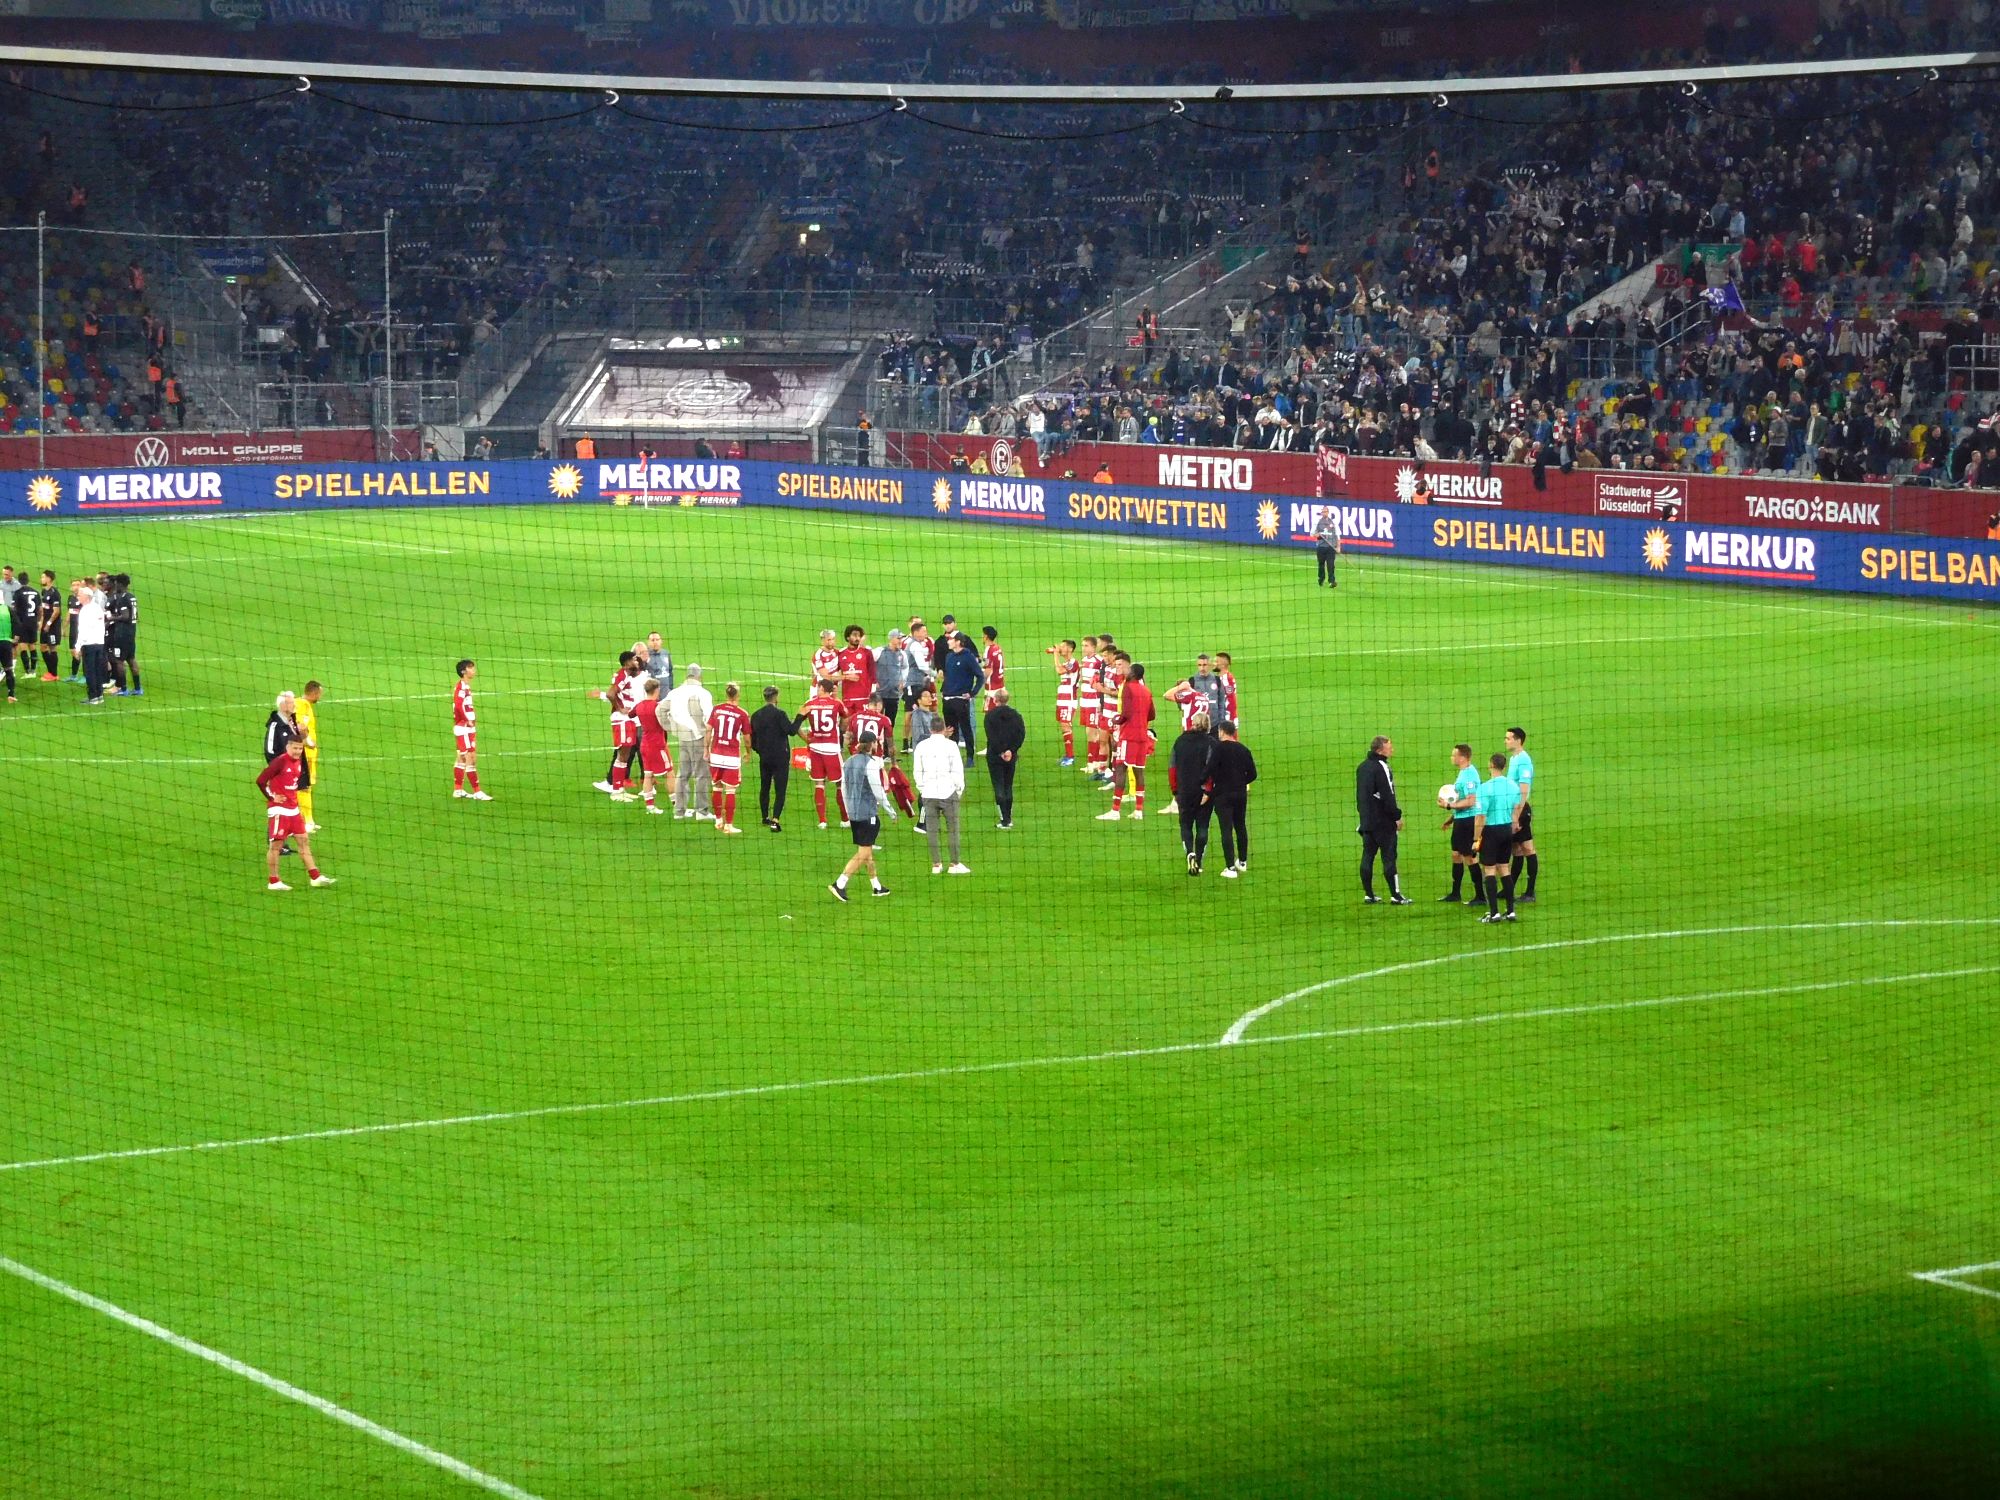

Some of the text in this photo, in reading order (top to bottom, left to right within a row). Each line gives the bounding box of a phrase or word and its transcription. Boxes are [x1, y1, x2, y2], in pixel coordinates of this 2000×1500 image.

[1663, 268, 1678, 286] 23
[182, 444, 303, 455] MOLL GRUPPE
[275, 471, 490, 498] SPIELHALLEN
[600, 464, 741, 490] MERKUR
[1159, 454, 1253, 491] METRO
[78, 472, 222, 501] MERKUR
[778, 472, 902, 504] SPIELBANKEN
[960, 480, 1045, 513] MERKUR
[1423, 473, 1502, 499] MERKUR
[1599, 483, 1652, 498] Stadtwerke
[1068, 493, 1226, 529] SPORTWETTEN
[1599, 497, 1651, 515] Düsseldorf
[1290, 503, 1393, 539] MERKUR
[1433, 518, 1605, 558] SPIELHALLEN
[1685, 530, 1815, 571] MERKUR
[27, 595, 36, 613] 5
[717, 715, 735, 740] 11
[810, 709, 834, 732] 15
